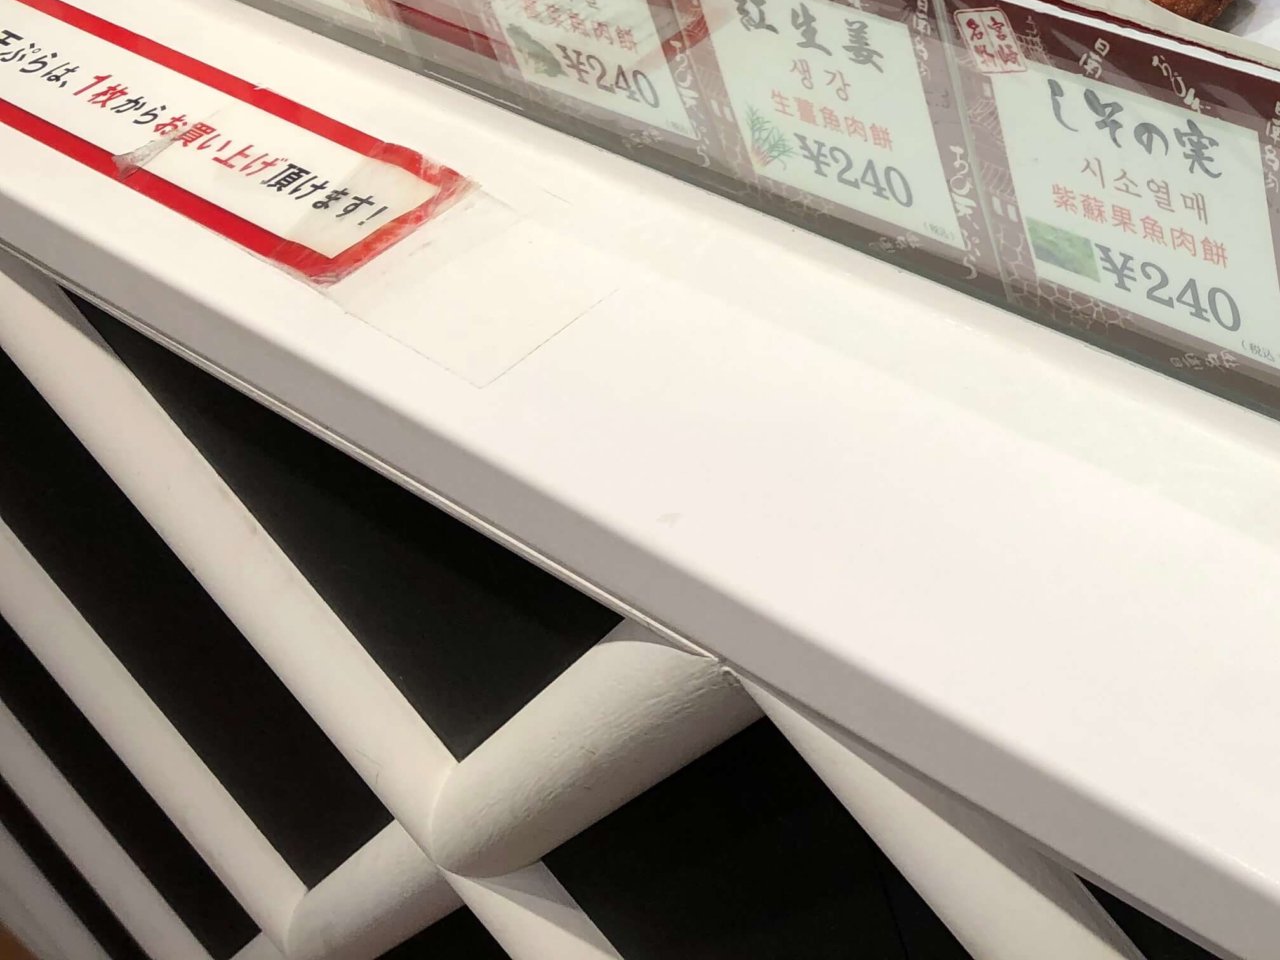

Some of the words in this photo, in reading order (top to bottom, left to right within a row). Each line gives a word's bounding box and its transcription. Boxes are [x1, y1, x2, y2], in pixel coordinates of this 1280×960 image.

[556, 43, 659, 108] ¥240
[791, 59, 851, 102] 생강
[1047, 78, 1222, 178] しその実
[794, 132, 913, 208] ¥240
[1081, 156, 1209, 224] 시소열매
[1051, 184, 1228, 269] 紫蘇果魚肉餅
[1094, 243, 1242, 332] ¥240
